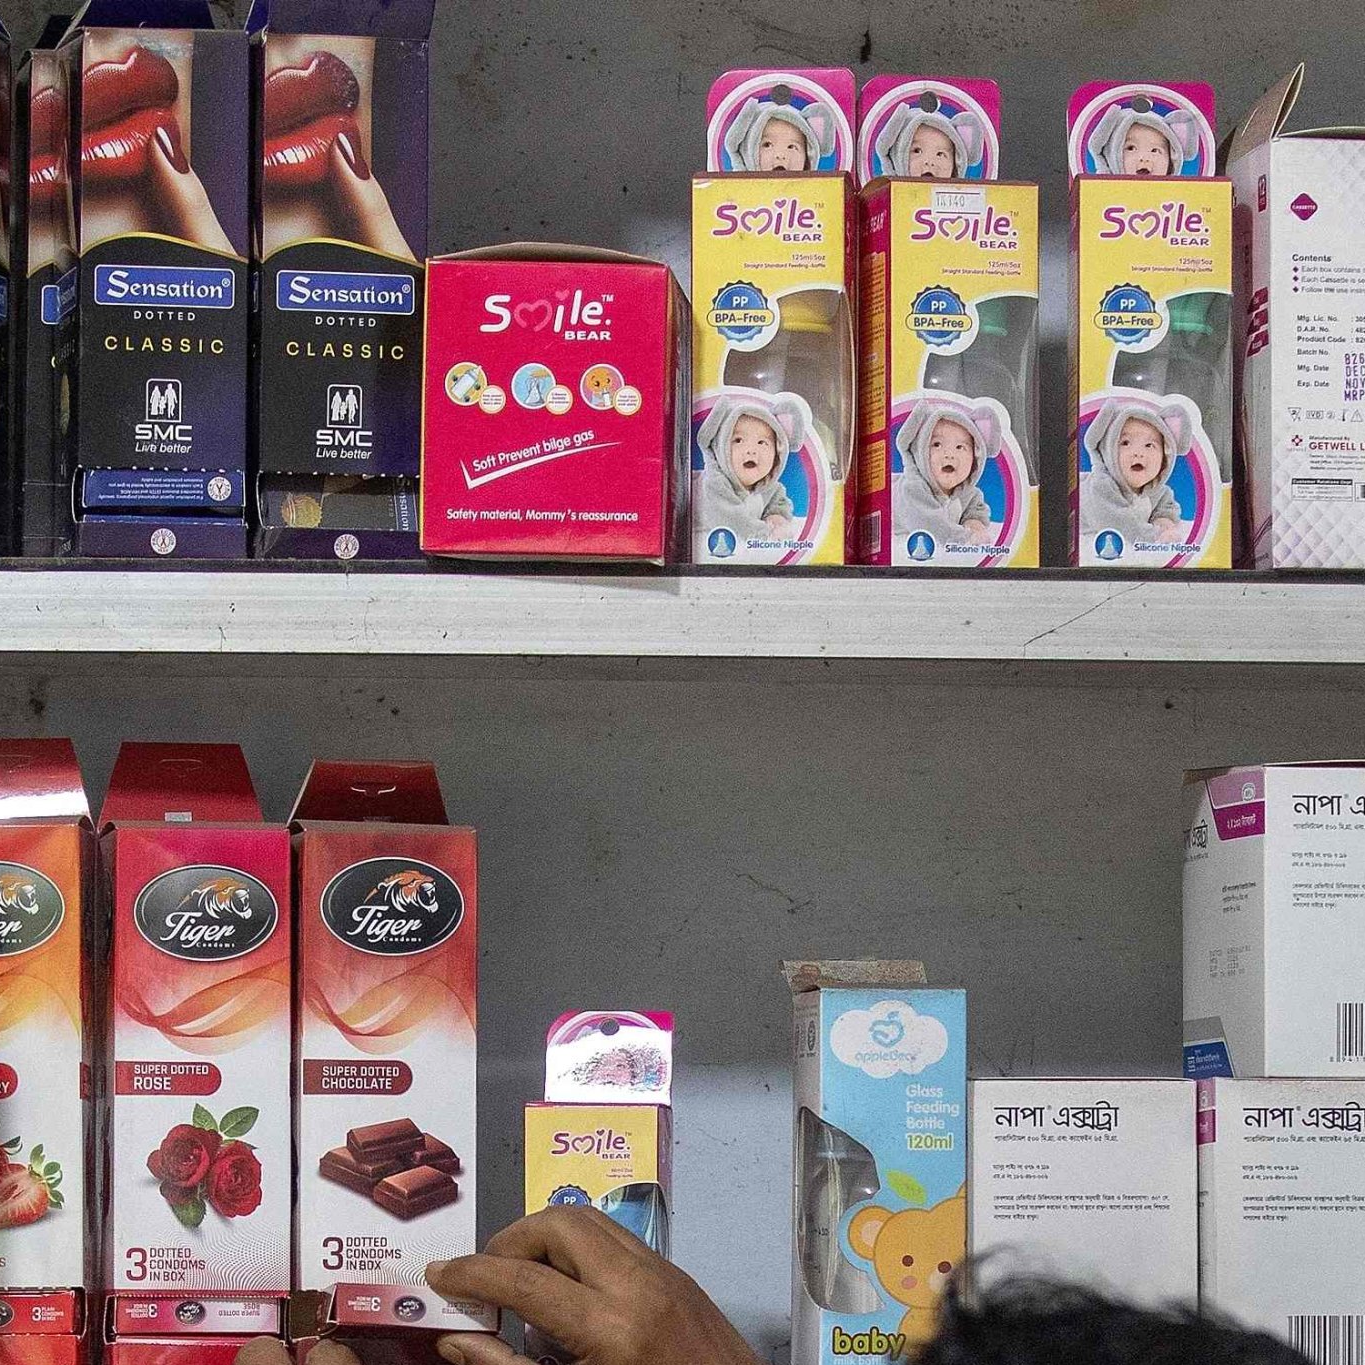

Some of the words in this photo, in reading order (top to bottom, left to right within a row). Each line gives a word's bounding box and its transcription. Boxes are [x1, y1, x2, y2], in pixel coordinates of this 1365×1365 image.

[979, 241, 1017, 249] BEAR
[1170, 238, 1209, 246] BEAR
[106, 269, 222, 299] Sensation
[289, 276, 404, 305] Sensation
[733, 296, 748, 307] PP
[931, 301, 947, 311] PP
[1120, 299, 1136, 309] PP
[134, 312, 196, 321] DOTTED
[315, 317, 376, 327] DOTTED
[715, 312, 766, 323] BPA-Free
[1103, 315, 1154, 326] BPA-Free
[914, 318, 964, 328] BPA-Free
[565, 330, 611, 341] BEAR
[105, 337, 223, 354] CLASSIC
[286, 342, 404, 359] CLASSIC
[1345, 365, 1365, 377] DEC
[1345, 377, 1365, 389] NOV
[135, 425, 192, 441] SMC
[316, 430, 372, 446] SMC
[473, 455, 496, 472] Soft
[499, 443, 541, 466] Prevent
[543, 436, 571, 456] bilge
[573, 429, 595, 446] gas
[1309, 442, 1356, 451] GETWELL
[446, 508, 477, 521] Safety
[480, 509, 523, 521] material,
[578, 512, 638, 522] reassurance
[1292, 794, 1341, 816] নাপা
[159, 912, 235, 948] Tiger
[346, 905, 423, 943] Tiger
[134, 1065, 169, 1075] SUPER
[170, 1065, 209, 1075] DOTTED
[322, 1066, 358, 1076] SUPER
[360, 1066, 399, 1077] DOTTED
[133, 1077, 171, 1090] ROSE
[322, 1077, 392, 1089] CHOCOLATE
[994, 1106, 1045, 1127] নাপা
[1243, 1107, 1294, 1127] নাপা
[906, 1134, 953, 1150] 120ml
[832, 1325, 906, 1357] baby
